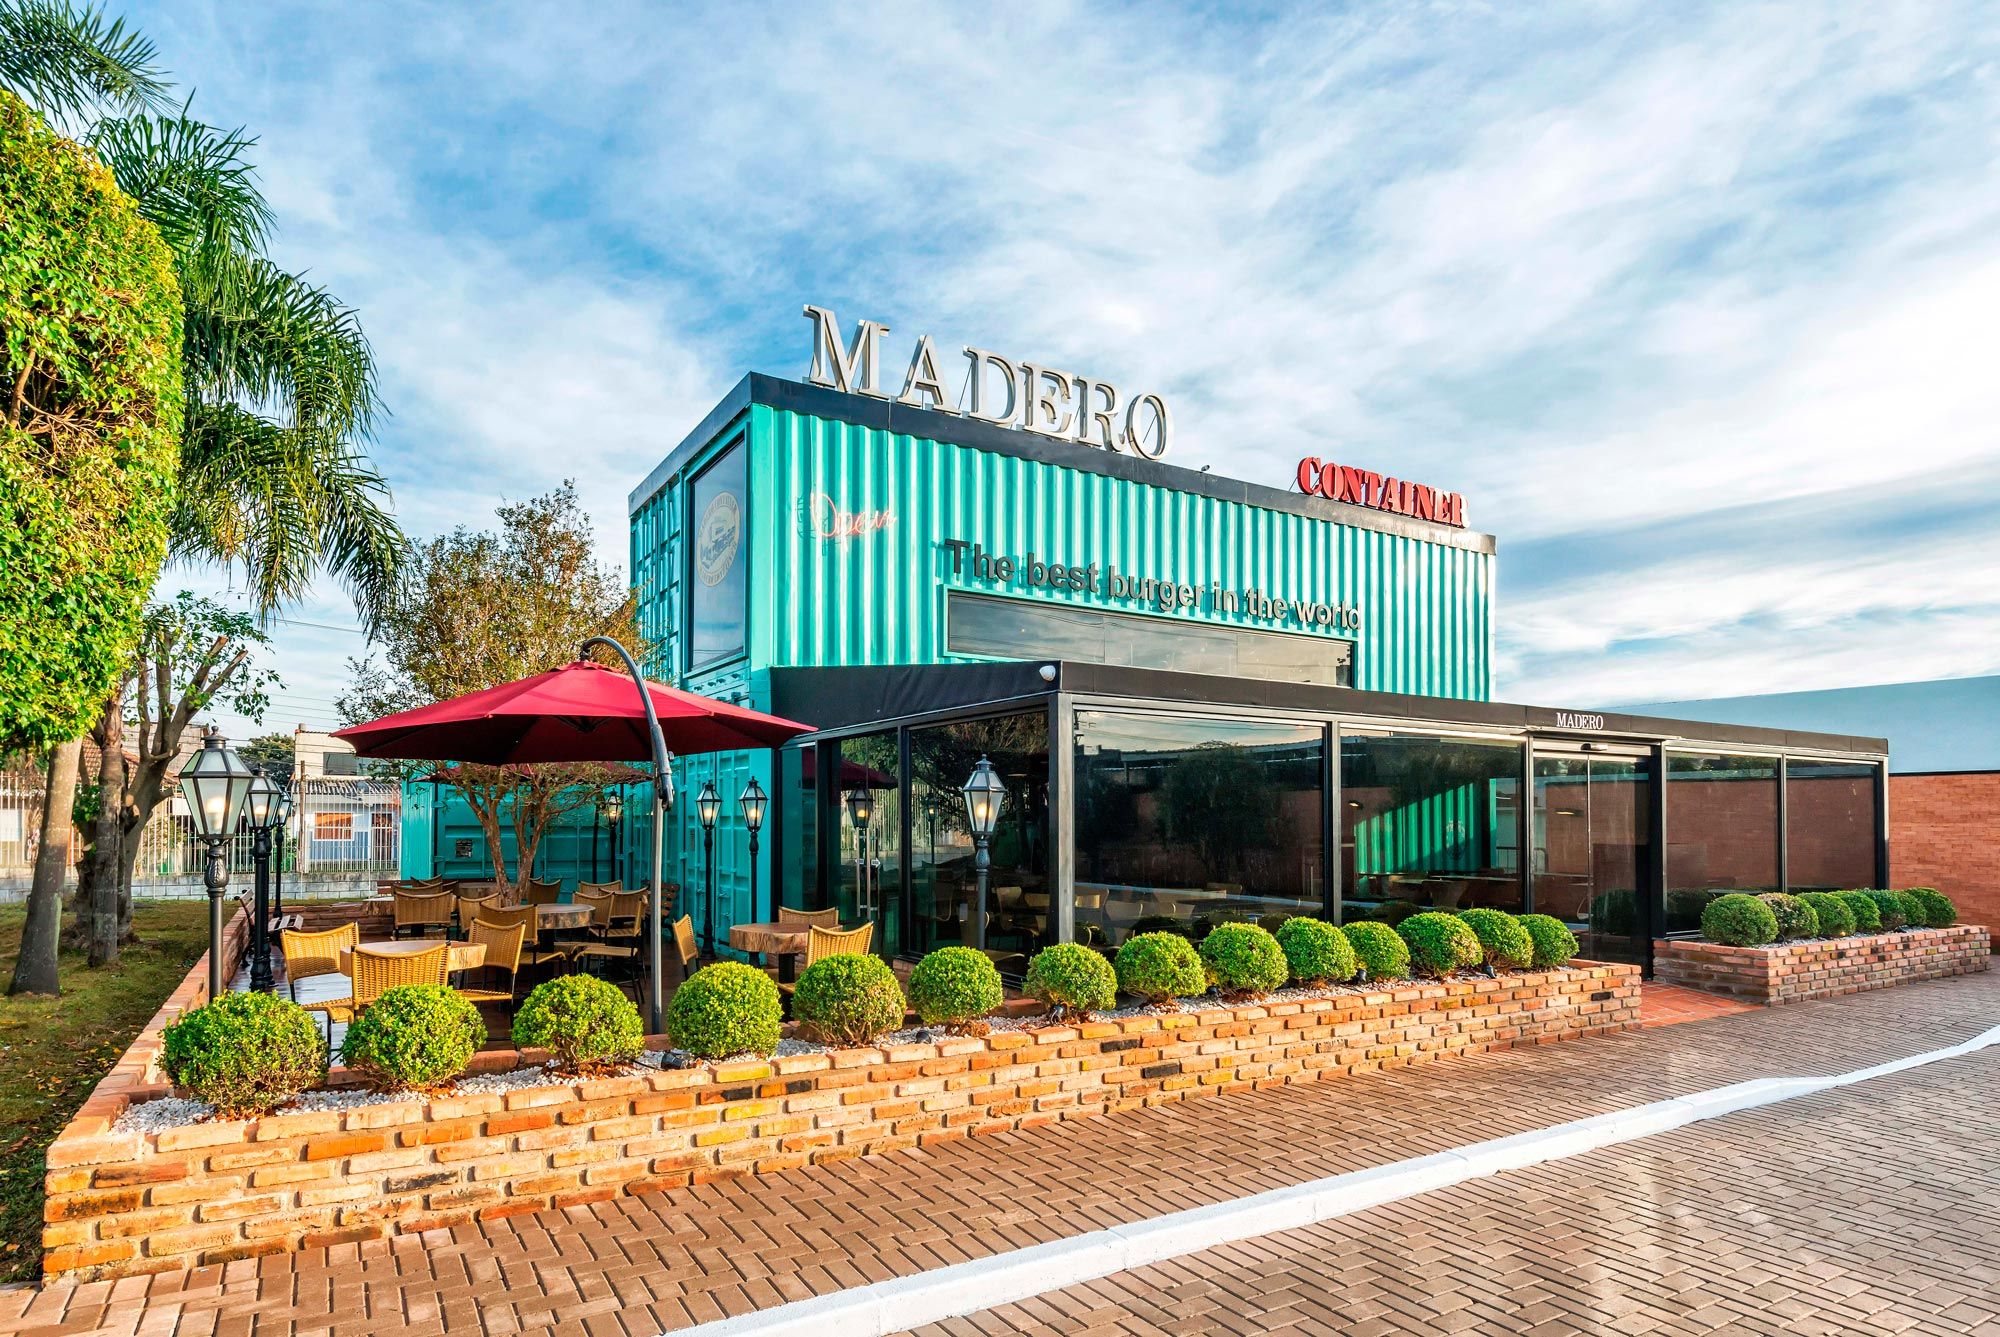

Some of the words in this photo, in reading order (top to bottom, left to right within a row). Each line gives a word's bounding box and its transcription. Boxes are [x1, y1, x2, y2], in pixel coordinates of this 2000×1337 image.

[803, 303, 1173, 460] MADERO
[1297, 456, 1470, 528] CONTAINER
[945, 538, 1015, 582] The
[1027, 552, 1099, 593] best
[1109, 565, 1204, 612] burger
[1213, 581, 1238, 613] in
[1245, 586, 1288, 620] the
[1294, 600, 1361, 630] world
[1556, 712, 1604, 730] MADERO
